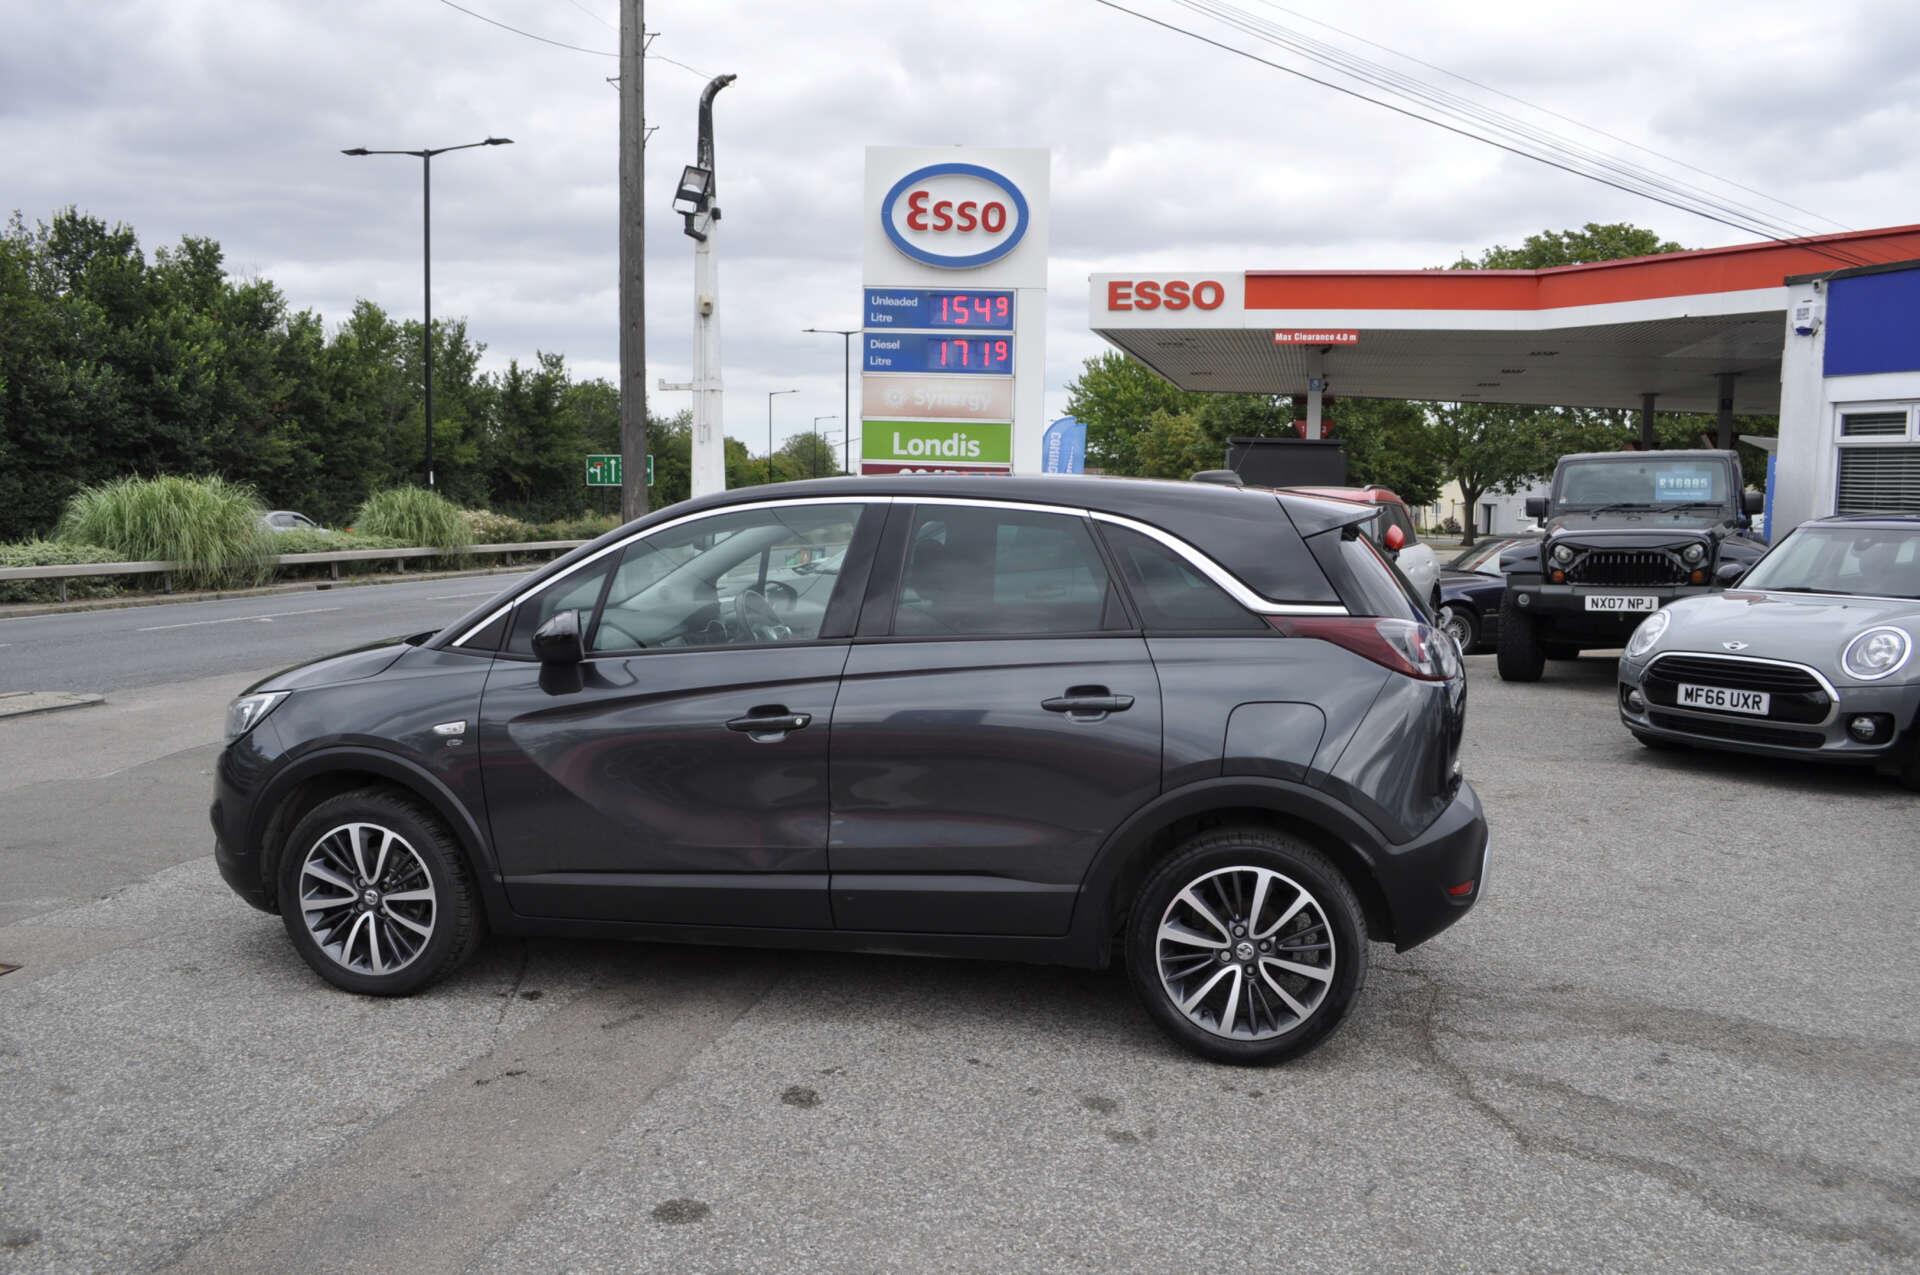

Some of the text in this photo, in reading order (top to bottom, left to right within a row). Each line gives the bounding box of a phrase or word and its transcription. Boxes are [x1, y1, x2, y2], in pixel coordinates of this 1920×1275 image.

[907, 190, 1007, 233] Esso
[871, 296, 918, 307] Unleaded
[1108, 280, 1225, 311] ESSO
[871, 312, 893, 323] Litre
[1275, 333, 1292, 341] Max
[1294, 332, 1335, 341] Clearance
[870, 339, 900, 350] Diesel
[870, 355, 892, 366] Litre
[912, 386, 992, 412] Synergy
[892, 431, 981, 457] Londis
[1591, 597, 1653, 609] NX07 NPJ
[1684, 687, 1762, 711] MF66 UXR
